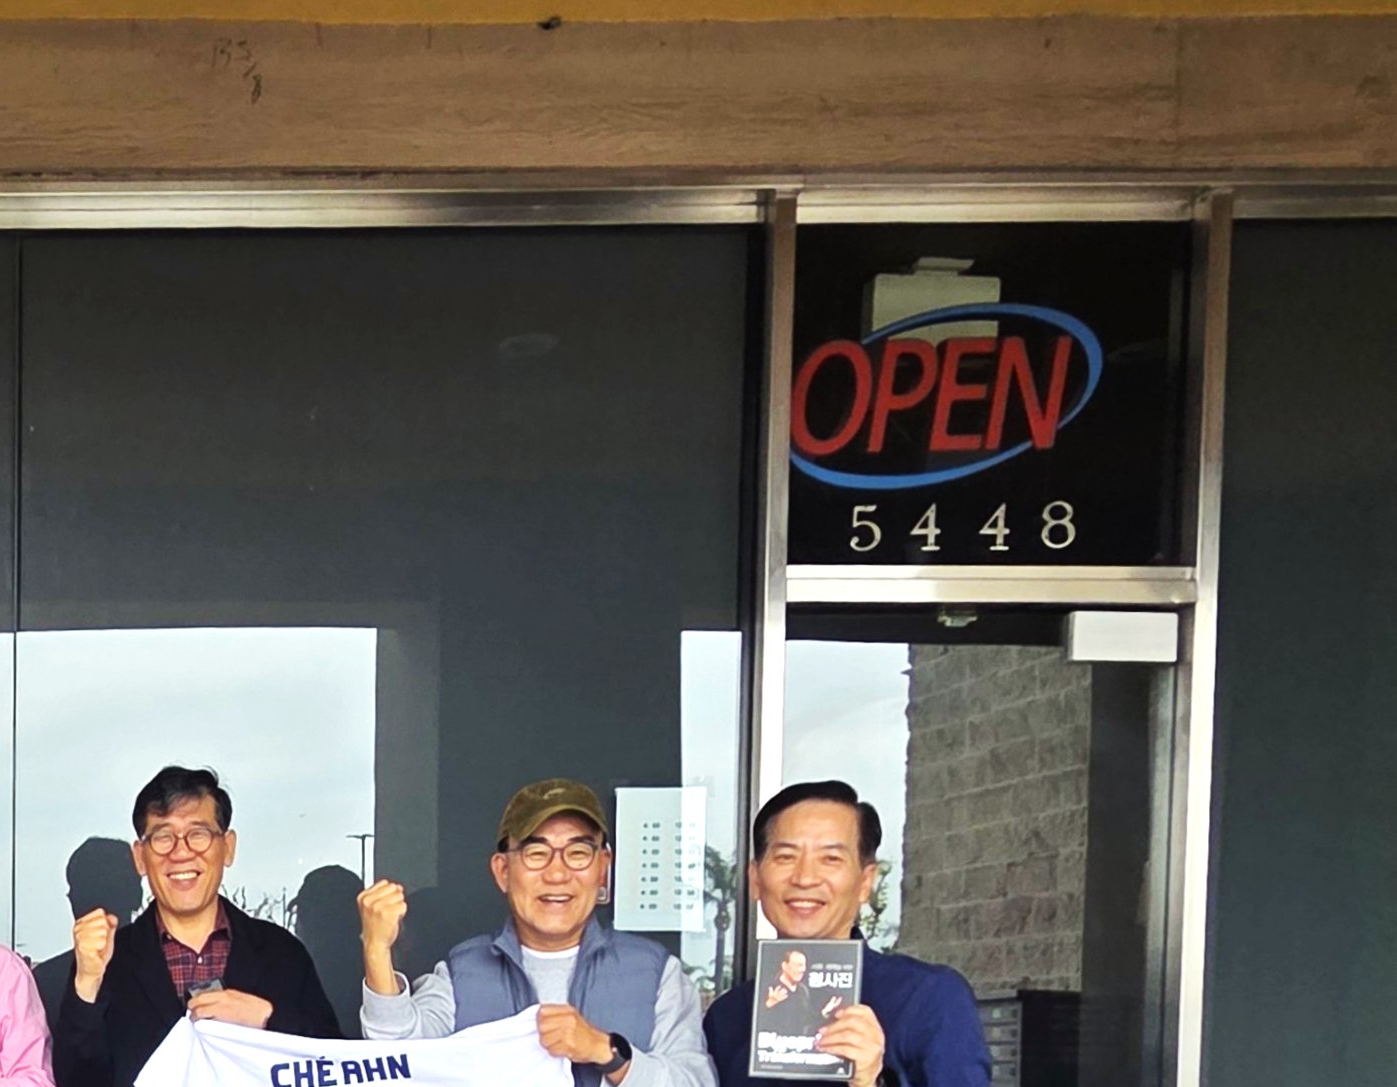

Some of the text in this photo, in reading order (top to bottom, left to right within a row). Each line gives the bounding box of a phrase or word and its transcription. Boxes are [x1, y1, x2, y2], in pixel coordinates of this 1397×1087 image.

[791, 336, 1072, 455] OPEN
[849, 500, 1077, 552] 5448
[341, 1053, 412, 1085] AHN
